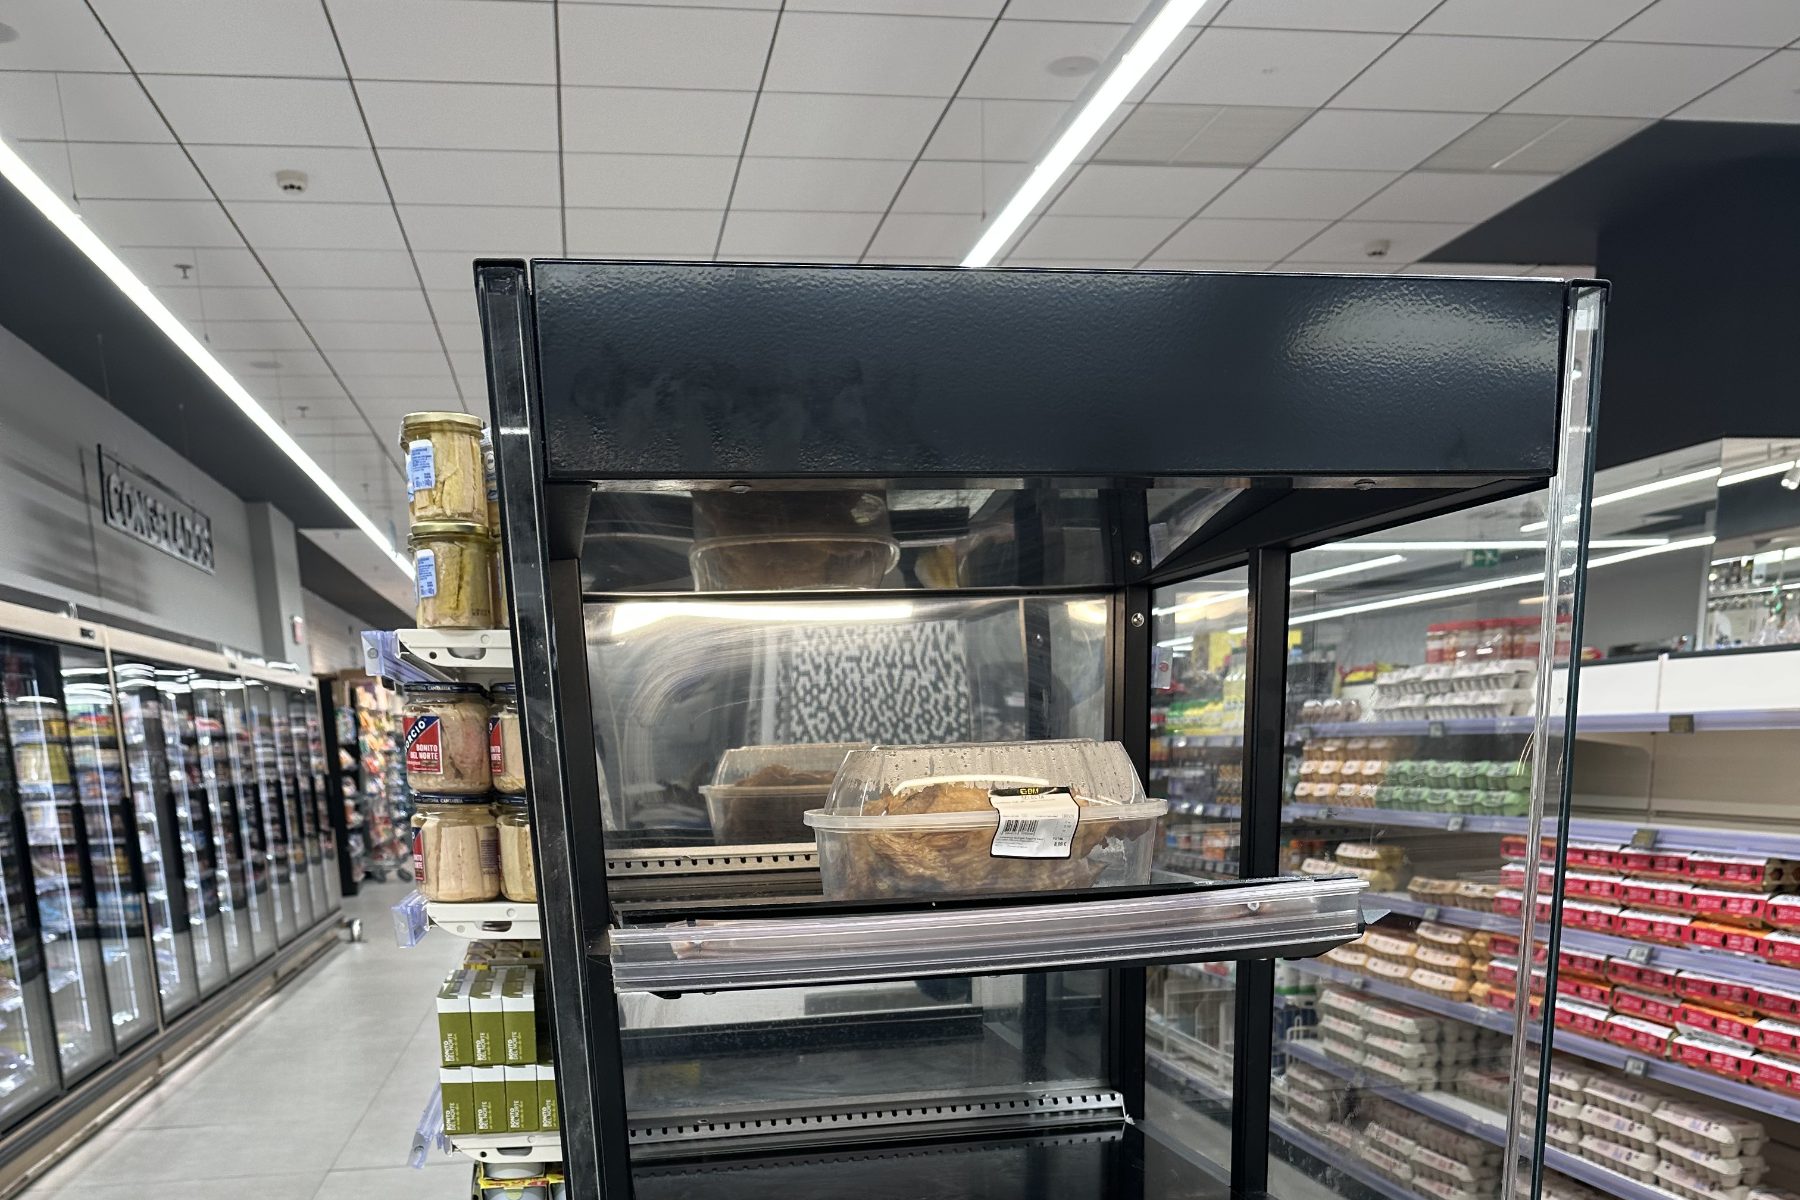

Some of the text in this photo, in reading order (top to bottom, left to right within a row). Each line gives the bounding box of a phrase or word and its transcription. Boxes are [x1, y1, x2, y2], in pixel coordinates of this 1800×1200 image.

[404, 719, 426, 751] ORCIO
[416, 744, 438, 752] BONITO
[419, 752, 438, 760] NORTE
